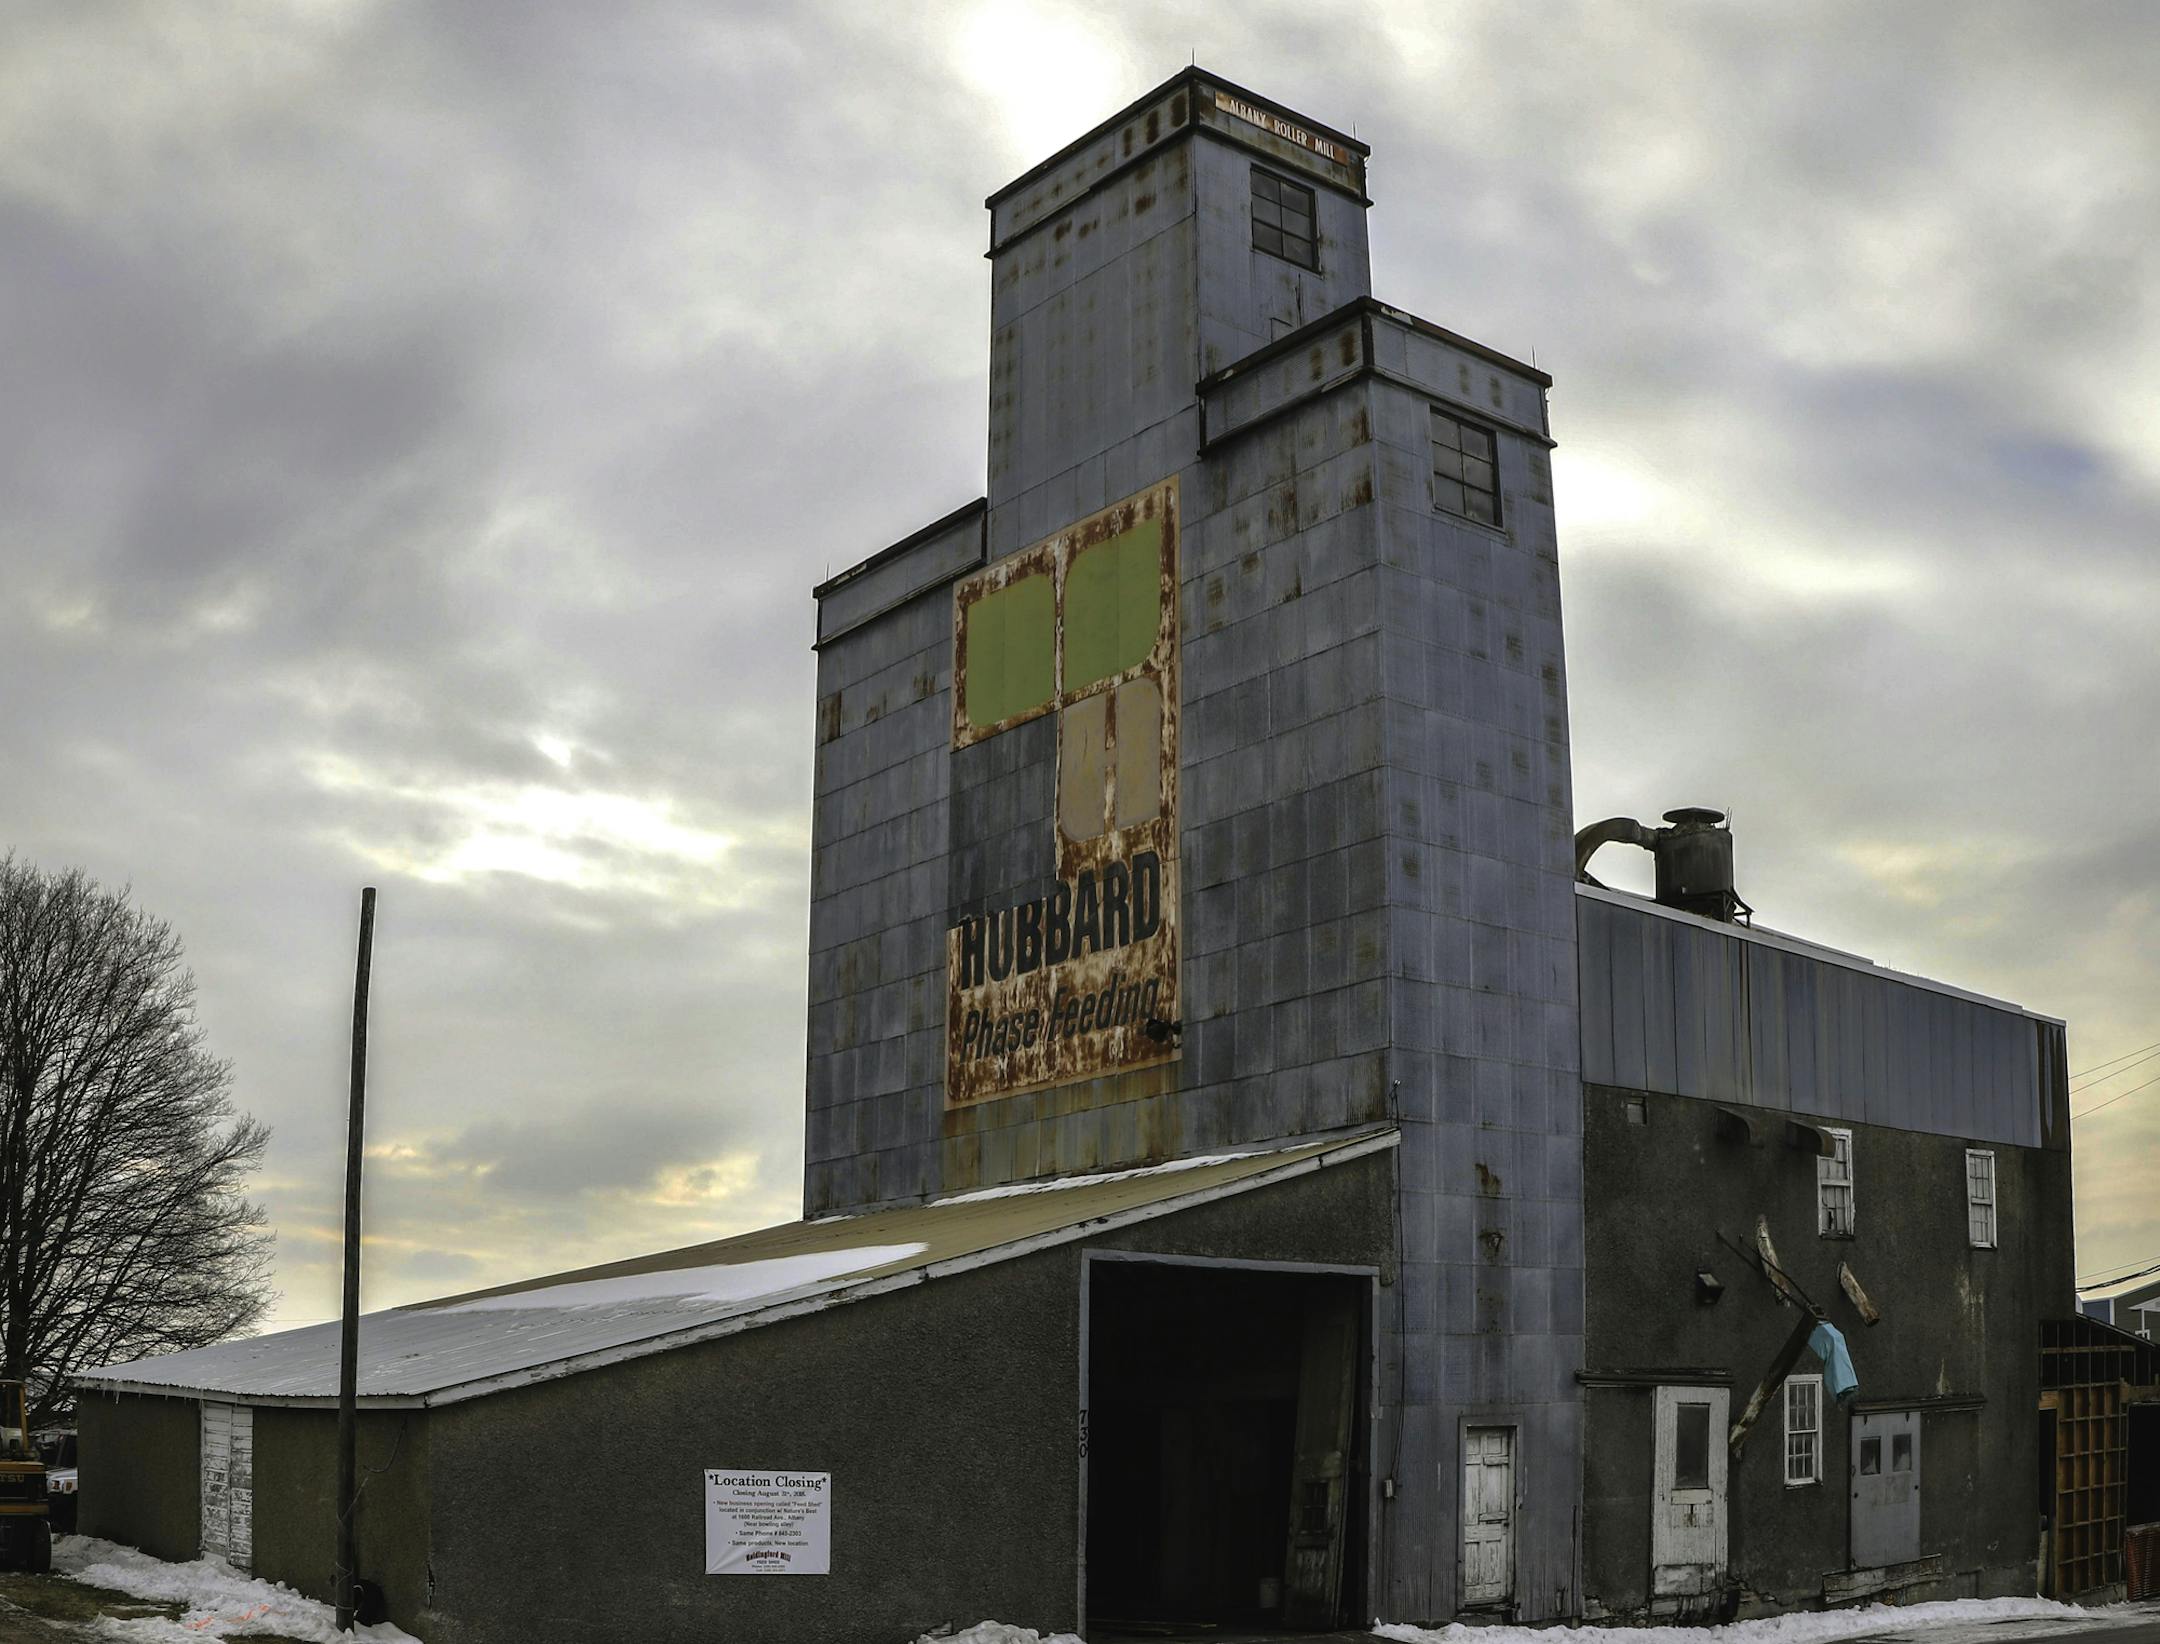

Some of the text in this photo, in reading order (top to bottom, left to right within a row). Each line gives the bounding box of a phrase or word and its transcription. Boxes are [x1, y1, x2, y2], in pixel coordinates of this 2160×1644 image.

[1228, 100, 1335, 159] ALBANY ROLLER MILL
[960, 850, 1161, 989] HUBBARD
[960, 974, 1160, 1064] Phase Feeding
[1080, 1410, 1088, 1458] 730
